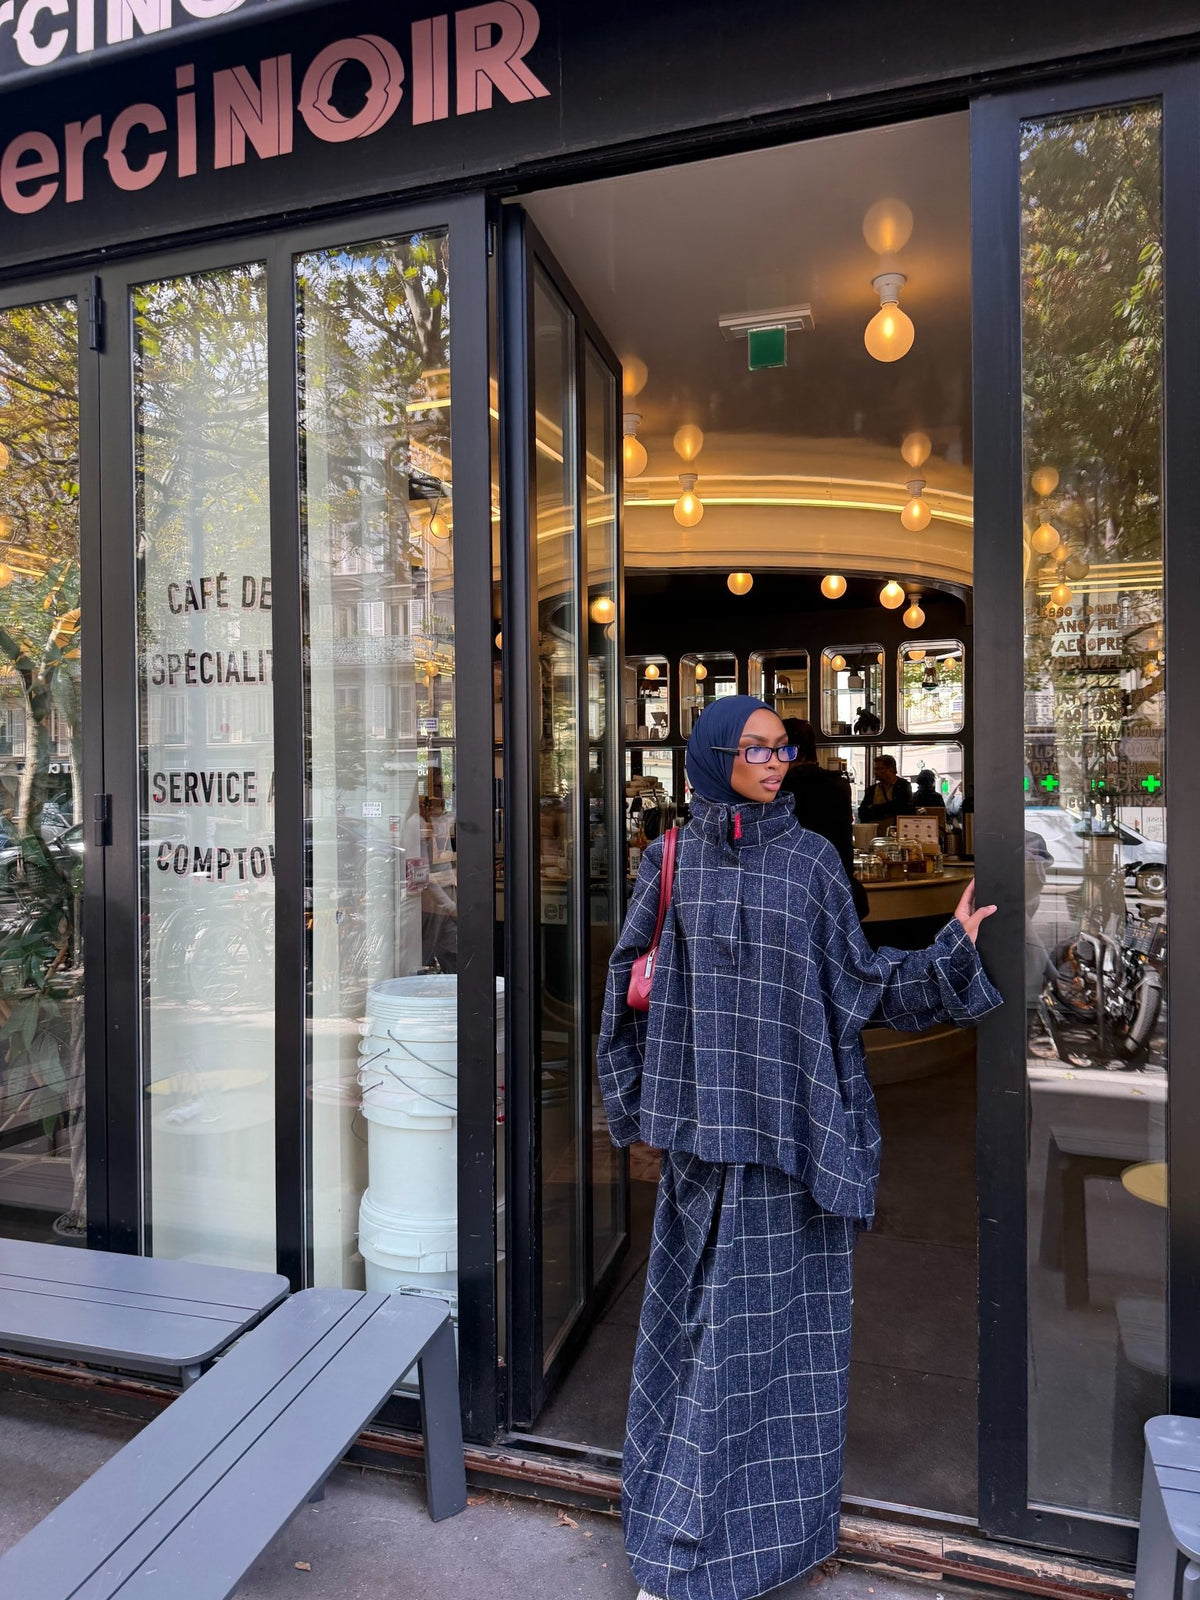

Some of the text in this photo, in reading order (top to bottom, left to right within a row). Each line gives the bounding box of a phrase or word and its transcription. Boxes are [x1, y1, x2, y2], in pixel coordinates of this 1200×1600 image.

[167, 572, 272, 615] CAFÉ DE
[152, 771, 257, 805] SERVICE
